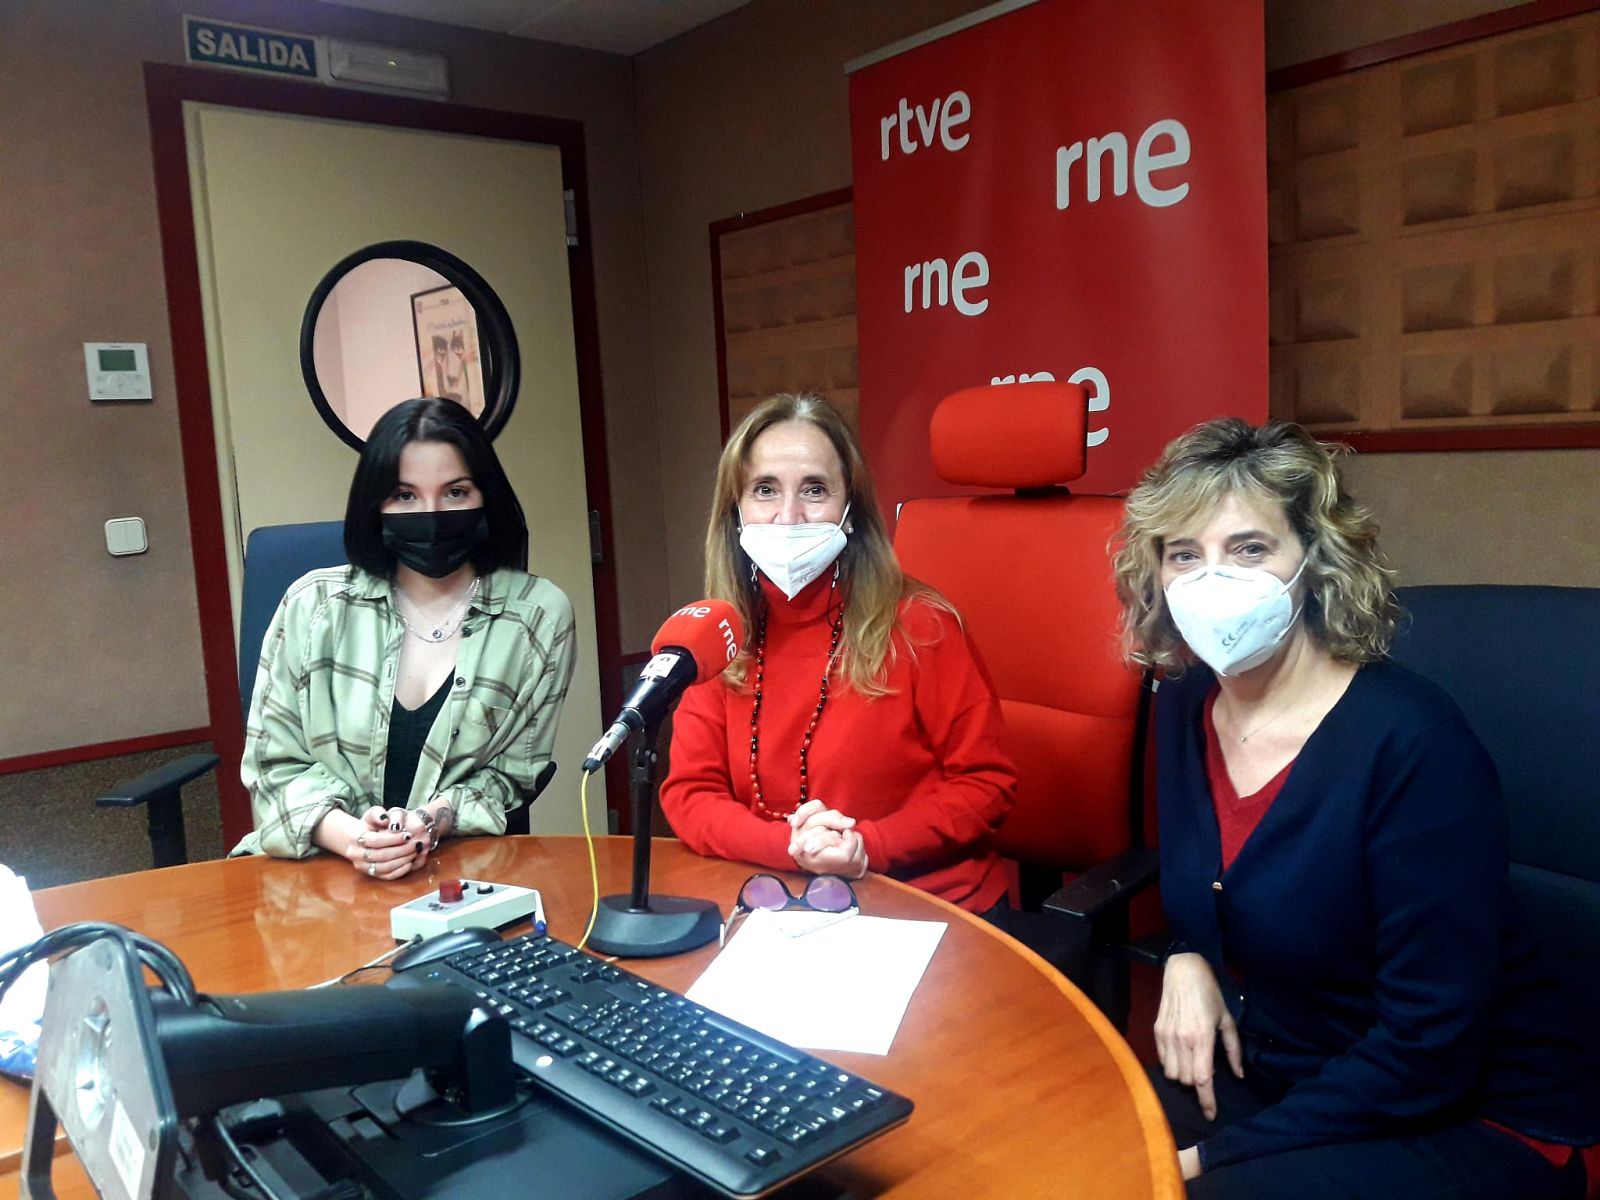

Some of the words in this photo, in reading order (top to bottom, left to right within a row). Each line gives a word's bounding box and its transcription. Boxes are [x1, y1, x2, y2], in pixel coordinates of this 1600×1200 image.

[196, 29, 310, 70] SALIDA
[880, 90, 971, 161] rtve
[1056, 119, 1191, 210] rne
[904, 251, 990, 316] rne
[718, 618, 737, 662] rne
